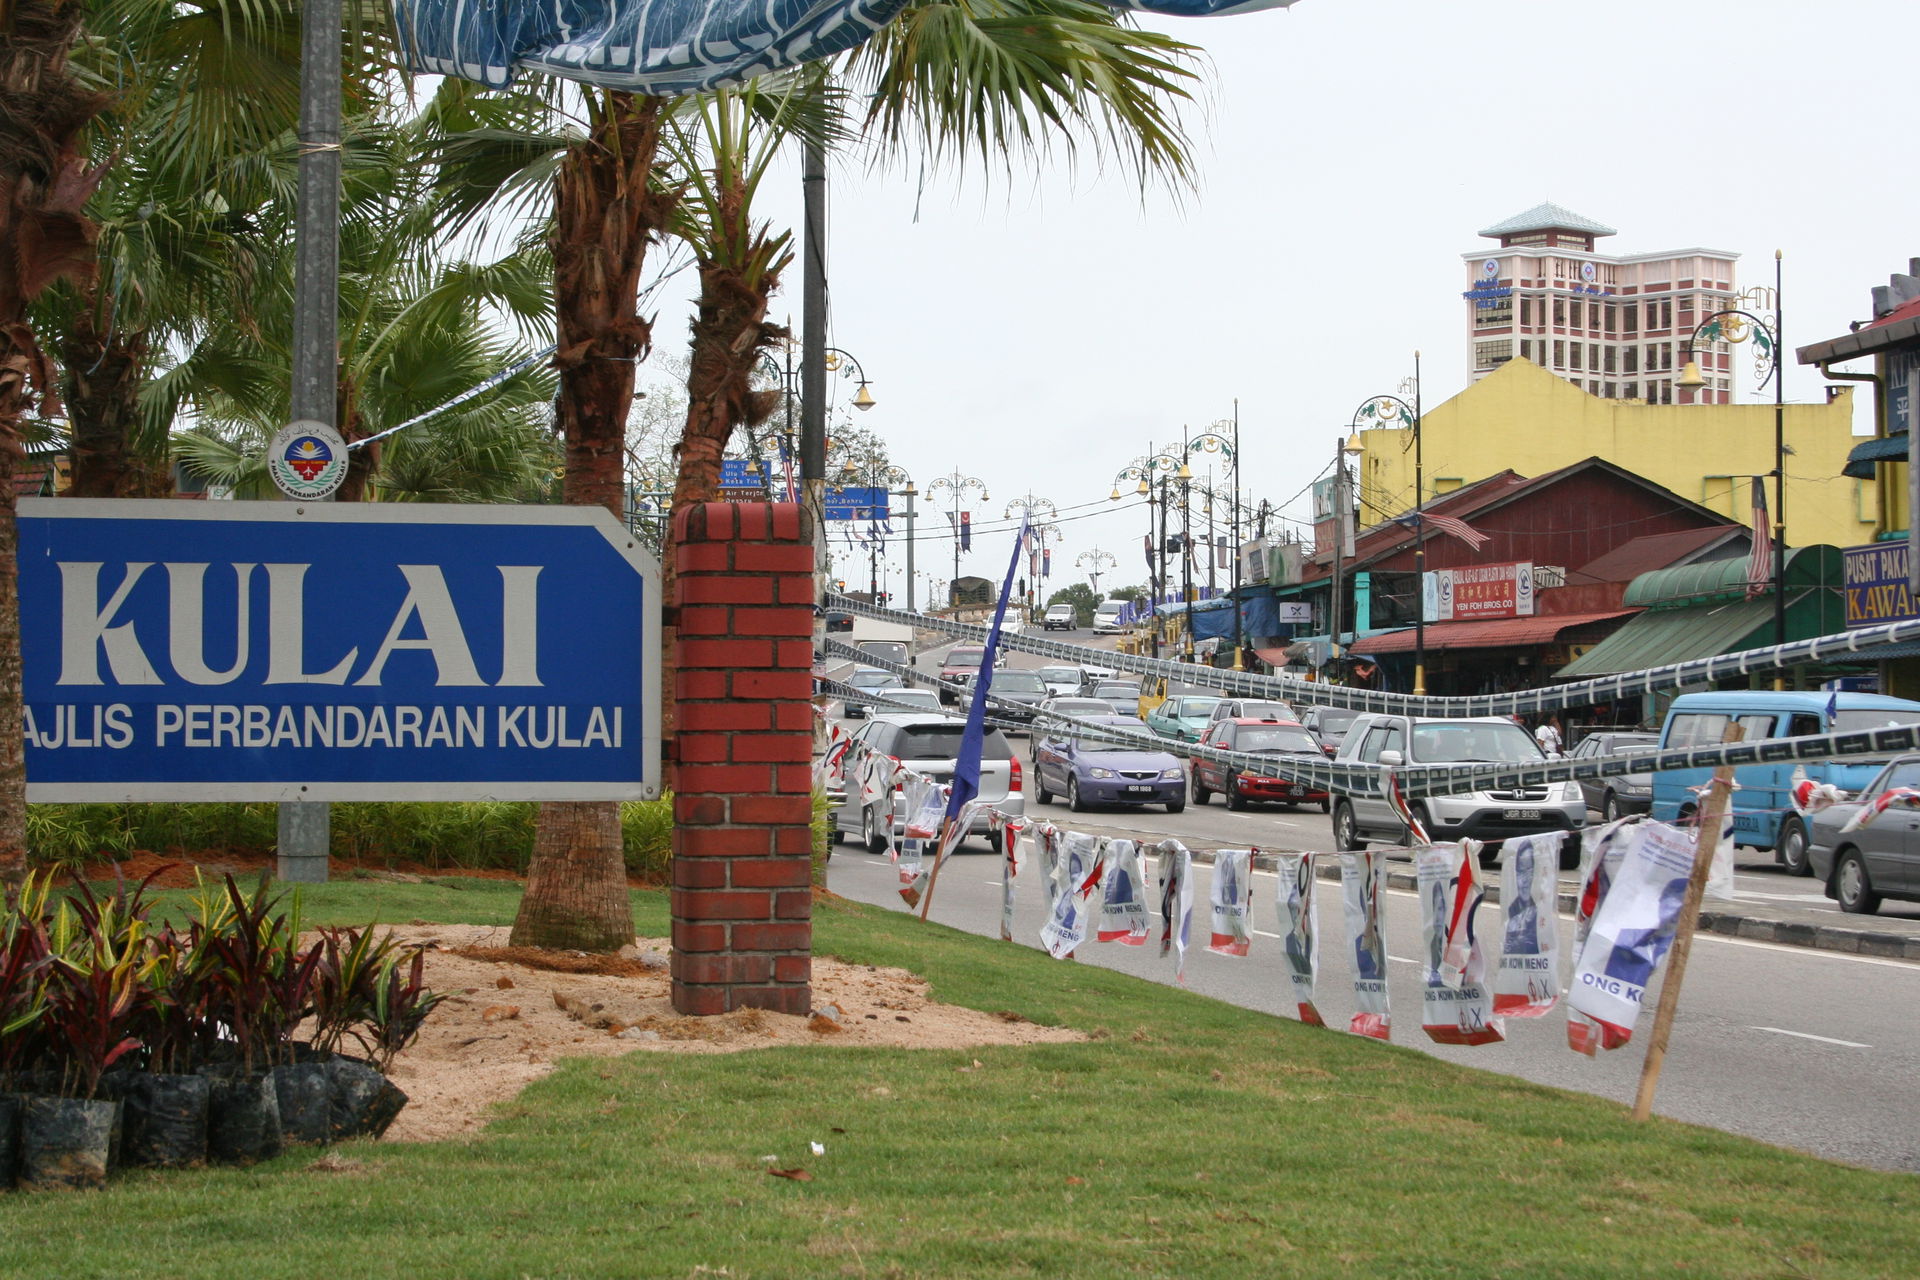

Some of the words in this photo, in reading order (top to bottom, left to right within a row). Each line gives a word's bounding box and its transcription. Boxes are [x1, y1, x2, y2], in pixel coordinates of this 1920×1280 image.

[271, 465, 286, 487] MAJLIS
[286, 485, 334, 498] PERBANDARAN
[334, 466, 347, 485] KULAI
[1845, 552, 1877, 585] PUSAT
[1880, 548, 1910, 580] PAKA
[1456, 601, 1469, 611] YEN
[1502, 599, 1514, 608] CO.
[56, 561, 545, 686] KULAI
[156, 704, 484, 749] PERBANDARAN
[498, 704, 622, 748] KULAI
[1521, 810, 1539, 818] 9130
[1524, 957, 1549, 970] MENG
[1582, 972, 1620, 995] ONG
